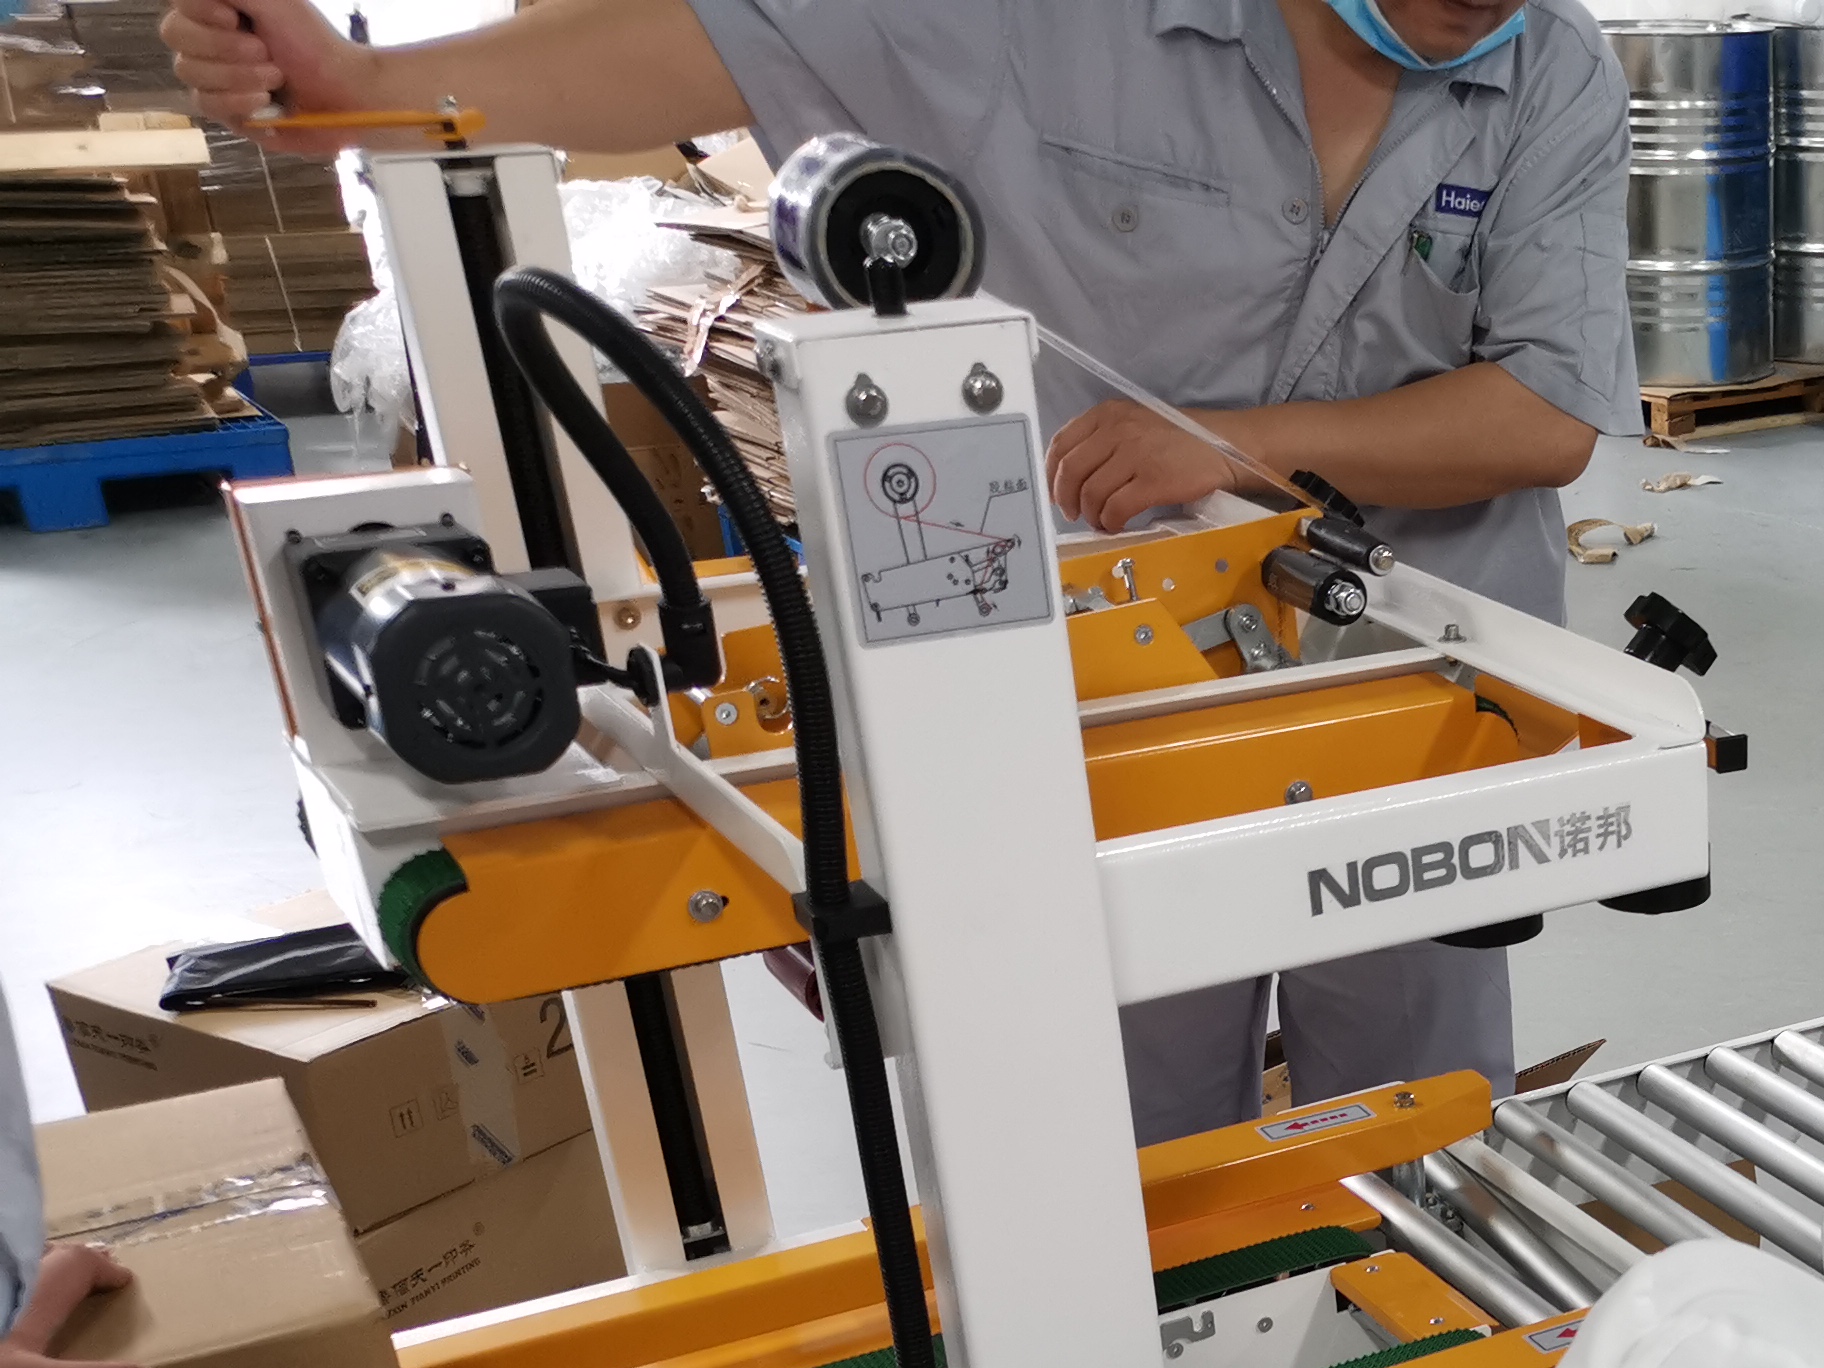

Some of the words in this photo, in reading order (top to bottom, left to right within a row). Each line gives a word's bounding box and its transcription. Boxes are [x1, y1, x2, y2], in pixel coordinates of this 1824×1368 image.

[1553, 802, 1633, 860] 诺邦
[1307, 818, 1552, 916] NOBON
[540, 997, 573, 1058] 2
